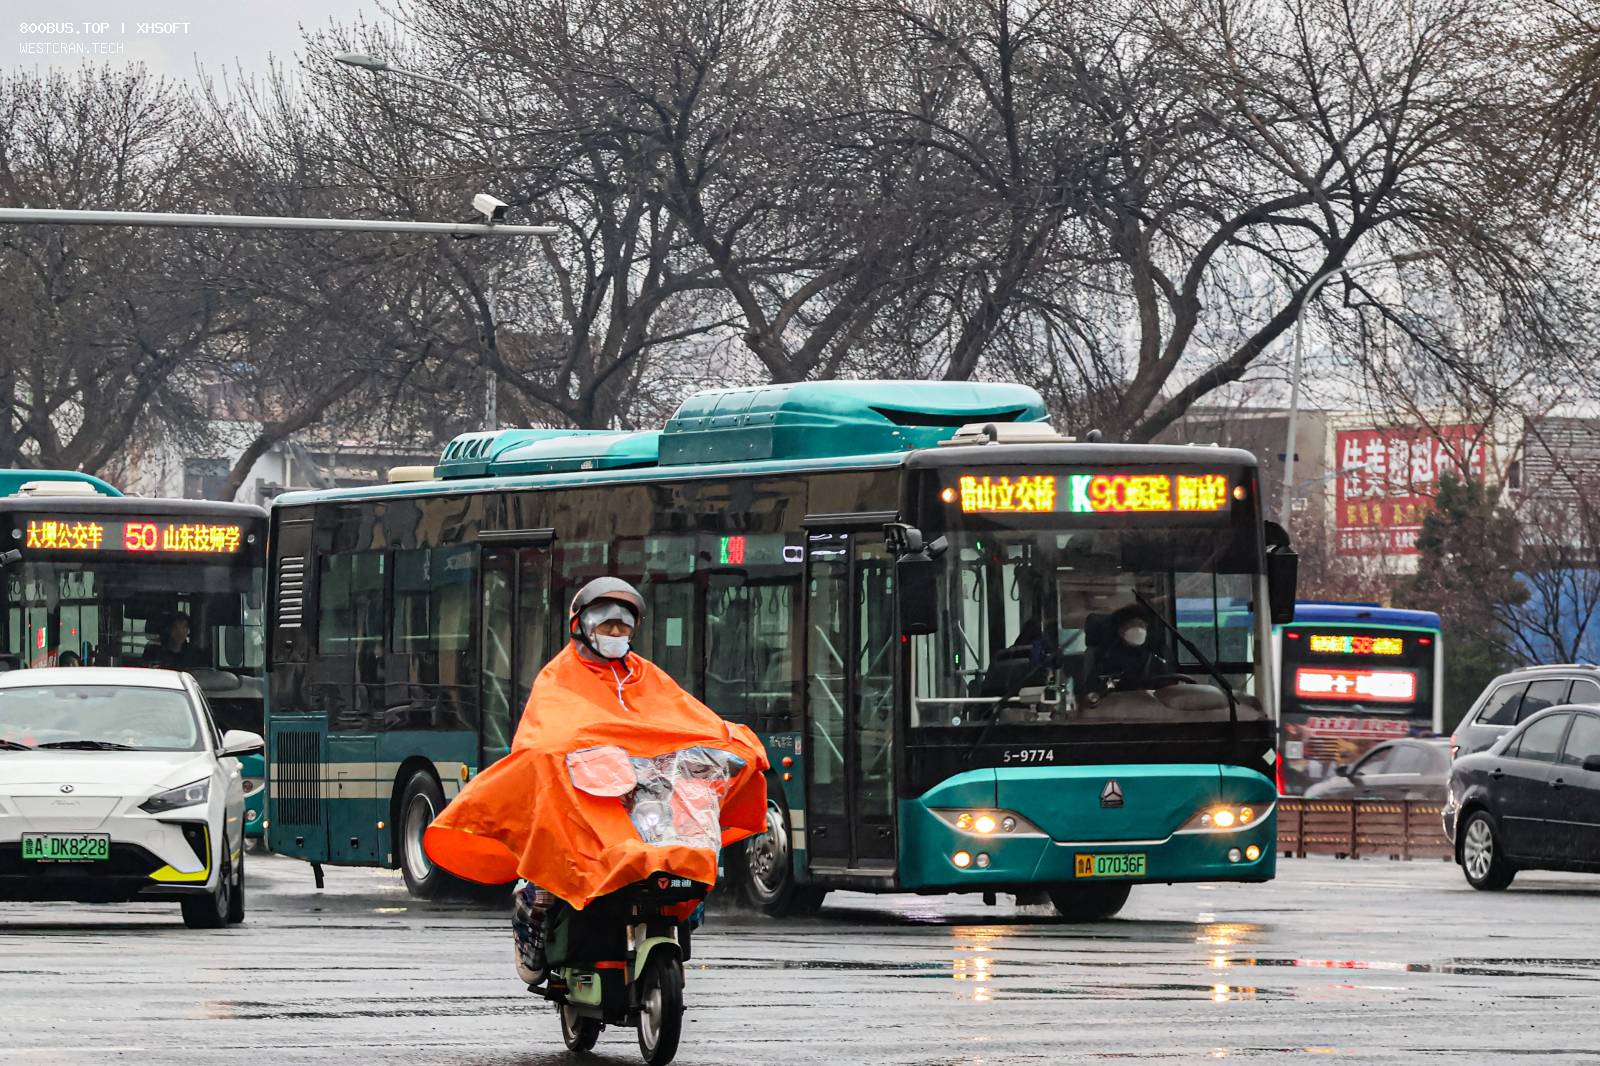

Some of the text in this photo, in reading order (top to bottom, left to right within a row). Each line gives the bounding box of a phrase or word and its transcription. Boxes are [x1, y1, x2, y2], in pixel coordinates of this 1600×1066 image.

[125, 522, 158, 550] 50
[163, 524, 241, 552] 山东技师学
[1003, 749, 1054, 763] 5-9774
